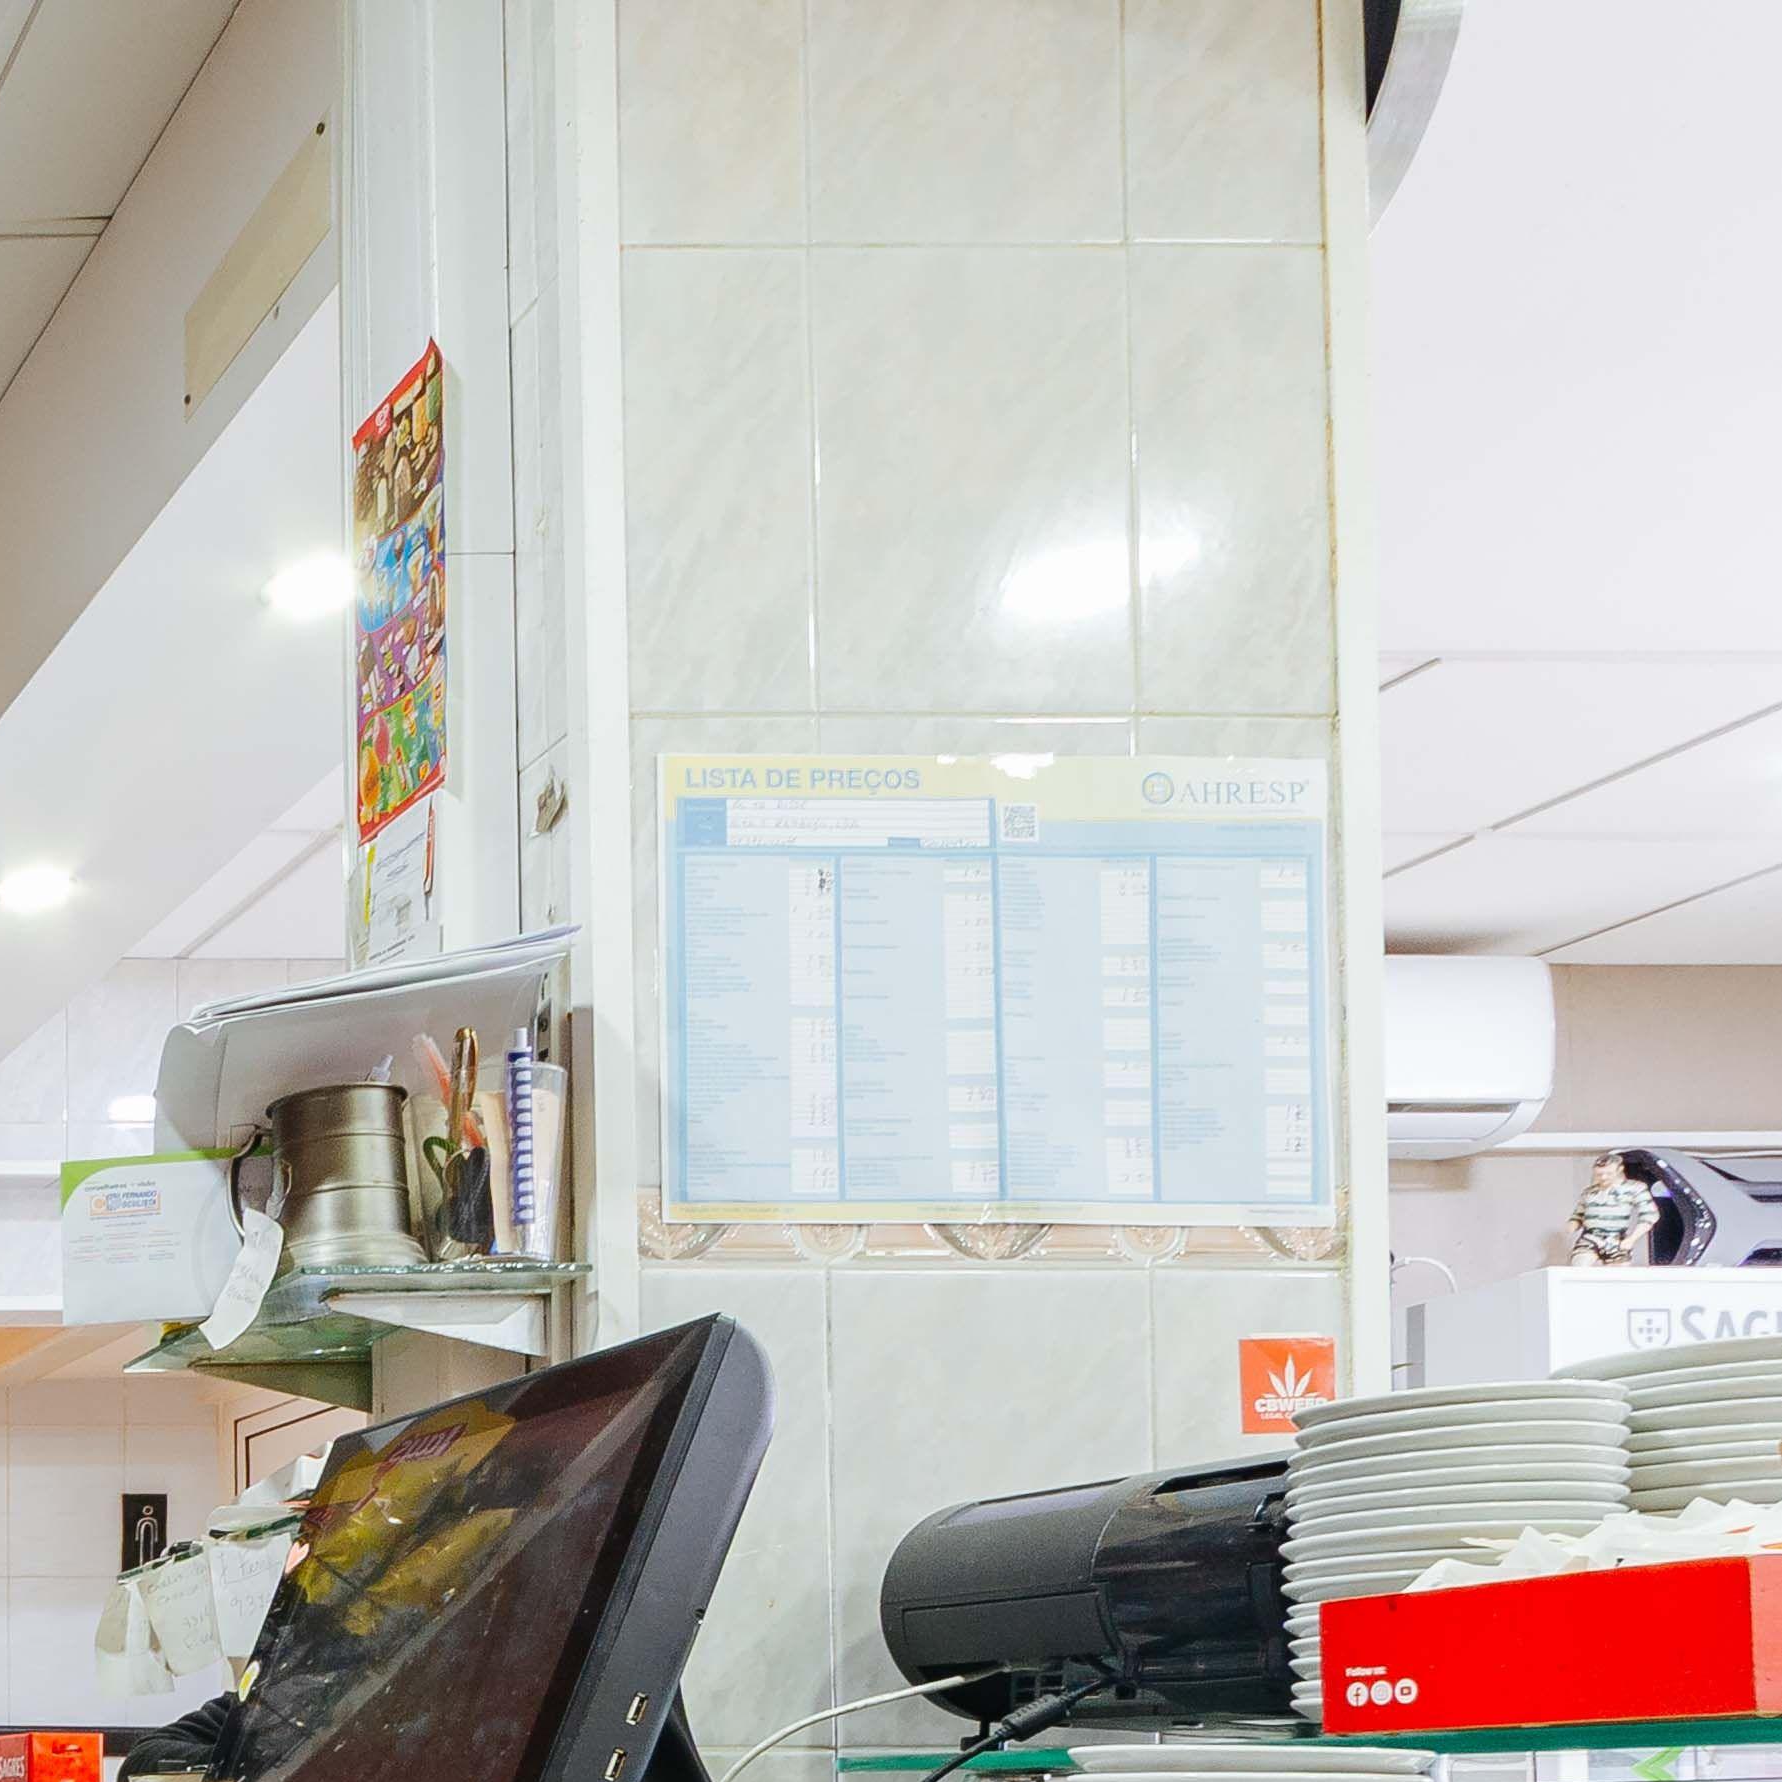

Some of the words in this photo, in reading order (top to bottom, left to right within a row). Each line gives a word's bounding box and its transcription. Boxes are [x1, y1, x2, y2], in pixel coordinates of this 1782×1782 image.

[685, 767, 757, 790] LISTA
[766, 768, 801, 790] DE
[809, 767, 921, 796] PREÇOS
[1180, 779, 1306, 805] AHRESP
[1680, 1304, 1782, 1341] SAG
